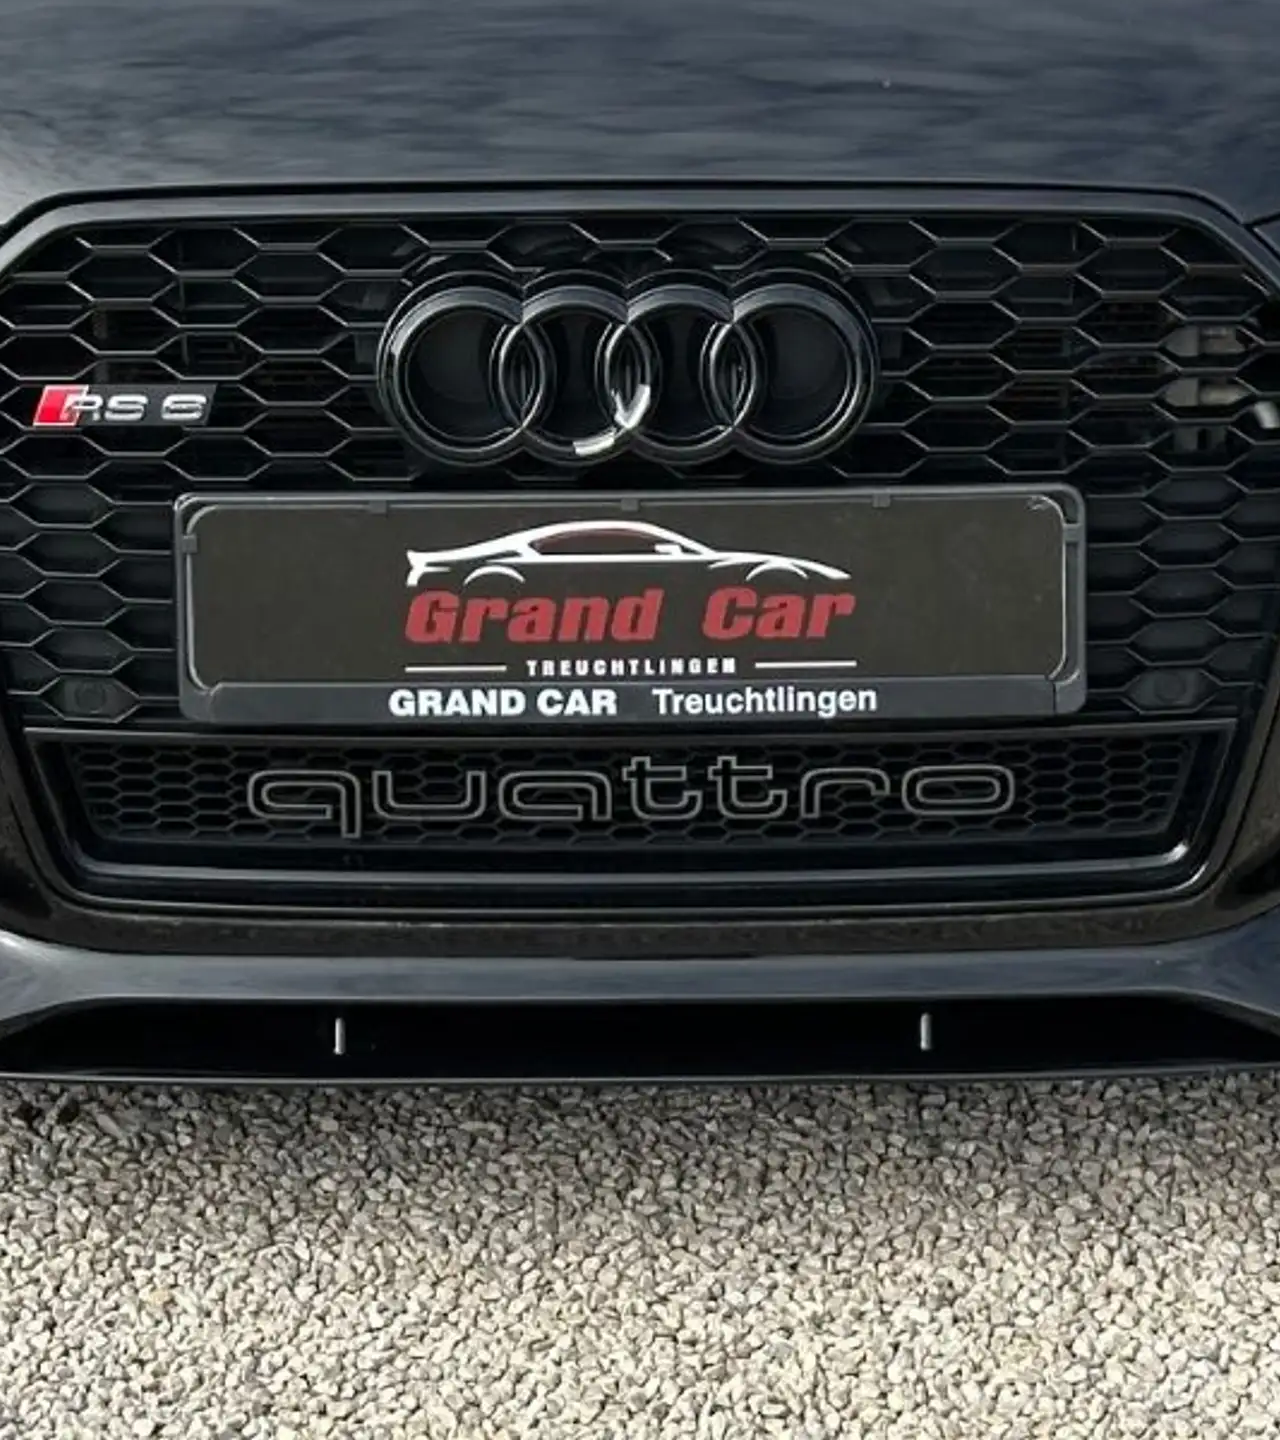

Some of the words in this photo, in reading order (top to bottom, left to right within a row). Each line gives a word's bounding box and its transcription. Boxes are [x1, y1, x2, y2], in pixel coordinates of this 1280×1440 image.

[404, 587, 666, 644] Grand
[701, 586, 857, 641] Car
[526, 657, 737, 677] TREUCHTLINGEN
[388, 687, 527, 717] GRAND
[536, 687, 618, 717] CAR
[651, 685, 878, 719] Treuchtlingen
[246, 755, 1016, 839] quattro
